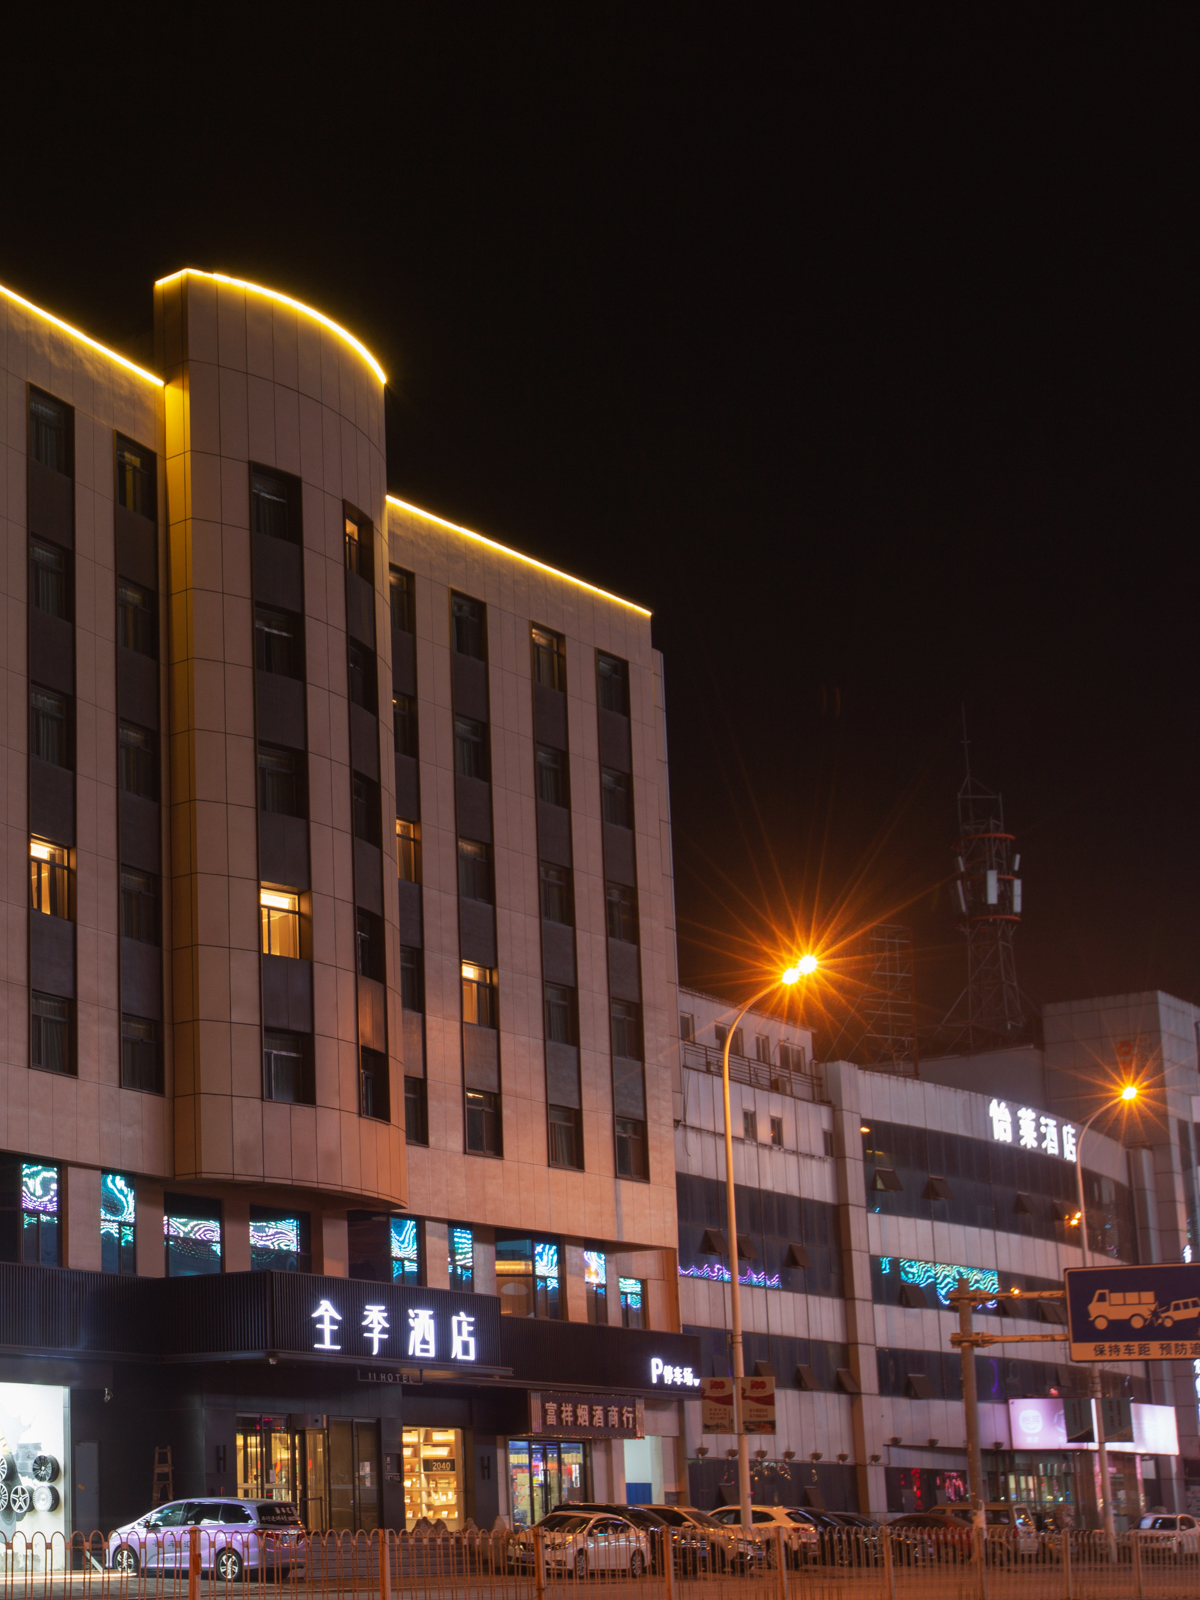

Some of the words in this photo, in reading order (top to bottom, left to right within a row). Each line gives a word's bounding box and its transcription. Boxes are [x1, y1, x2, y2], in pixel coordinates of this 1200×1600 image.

[989, 1098, 1077, 1163] 怡莱酒店
[311, 1300, 476, 1361] 全季酒店
[1094, 1343, 1151, 1357] 保持车距
[380, 1373, 414, 1383] HOTEL
[544, 1402, 634, 1429] 富祥烟酒商行
[432, 1461, 451, 1471] 2040
